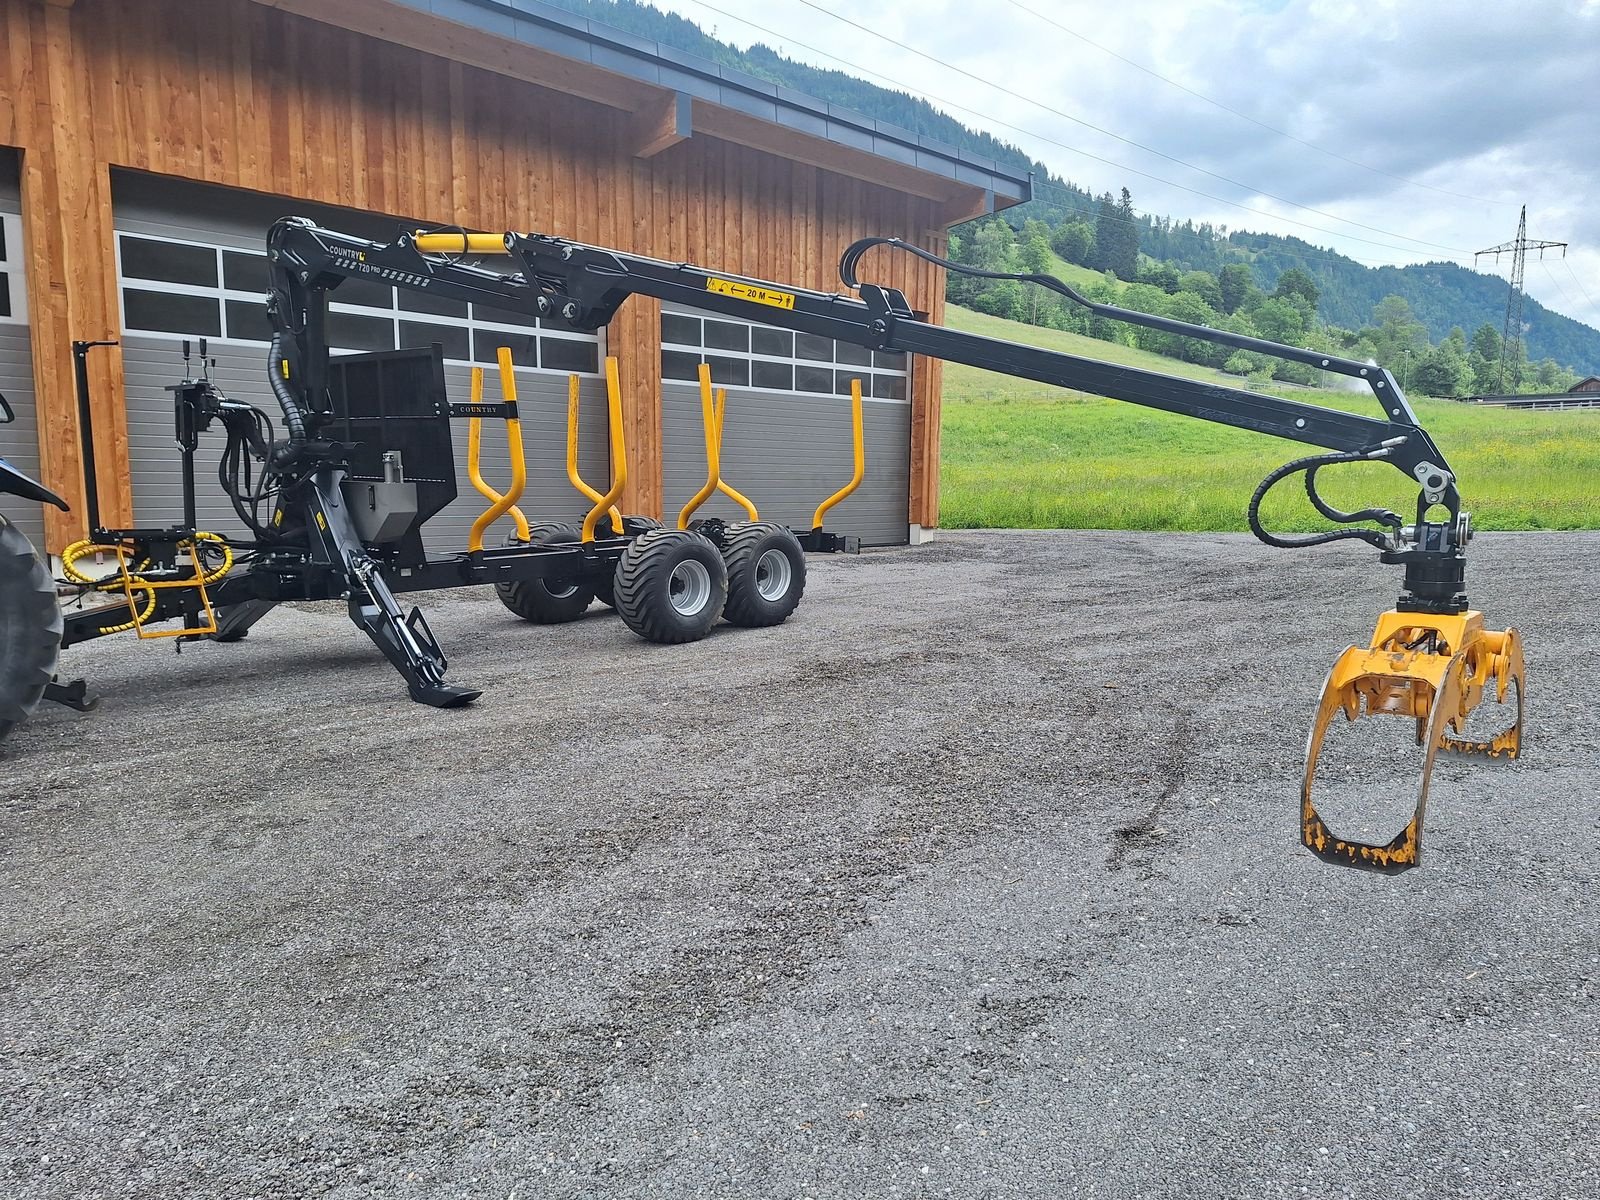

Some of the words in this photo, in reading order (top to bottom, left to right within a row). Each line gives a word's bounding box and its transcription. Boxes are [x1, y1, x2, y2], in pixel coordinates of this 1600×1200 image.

[329, 246, 359, 260] COUNTRY
[370, 265, 381, 274] PRO
[747, 289, 757, 298] 20
[758, 291, 766, 300] M
